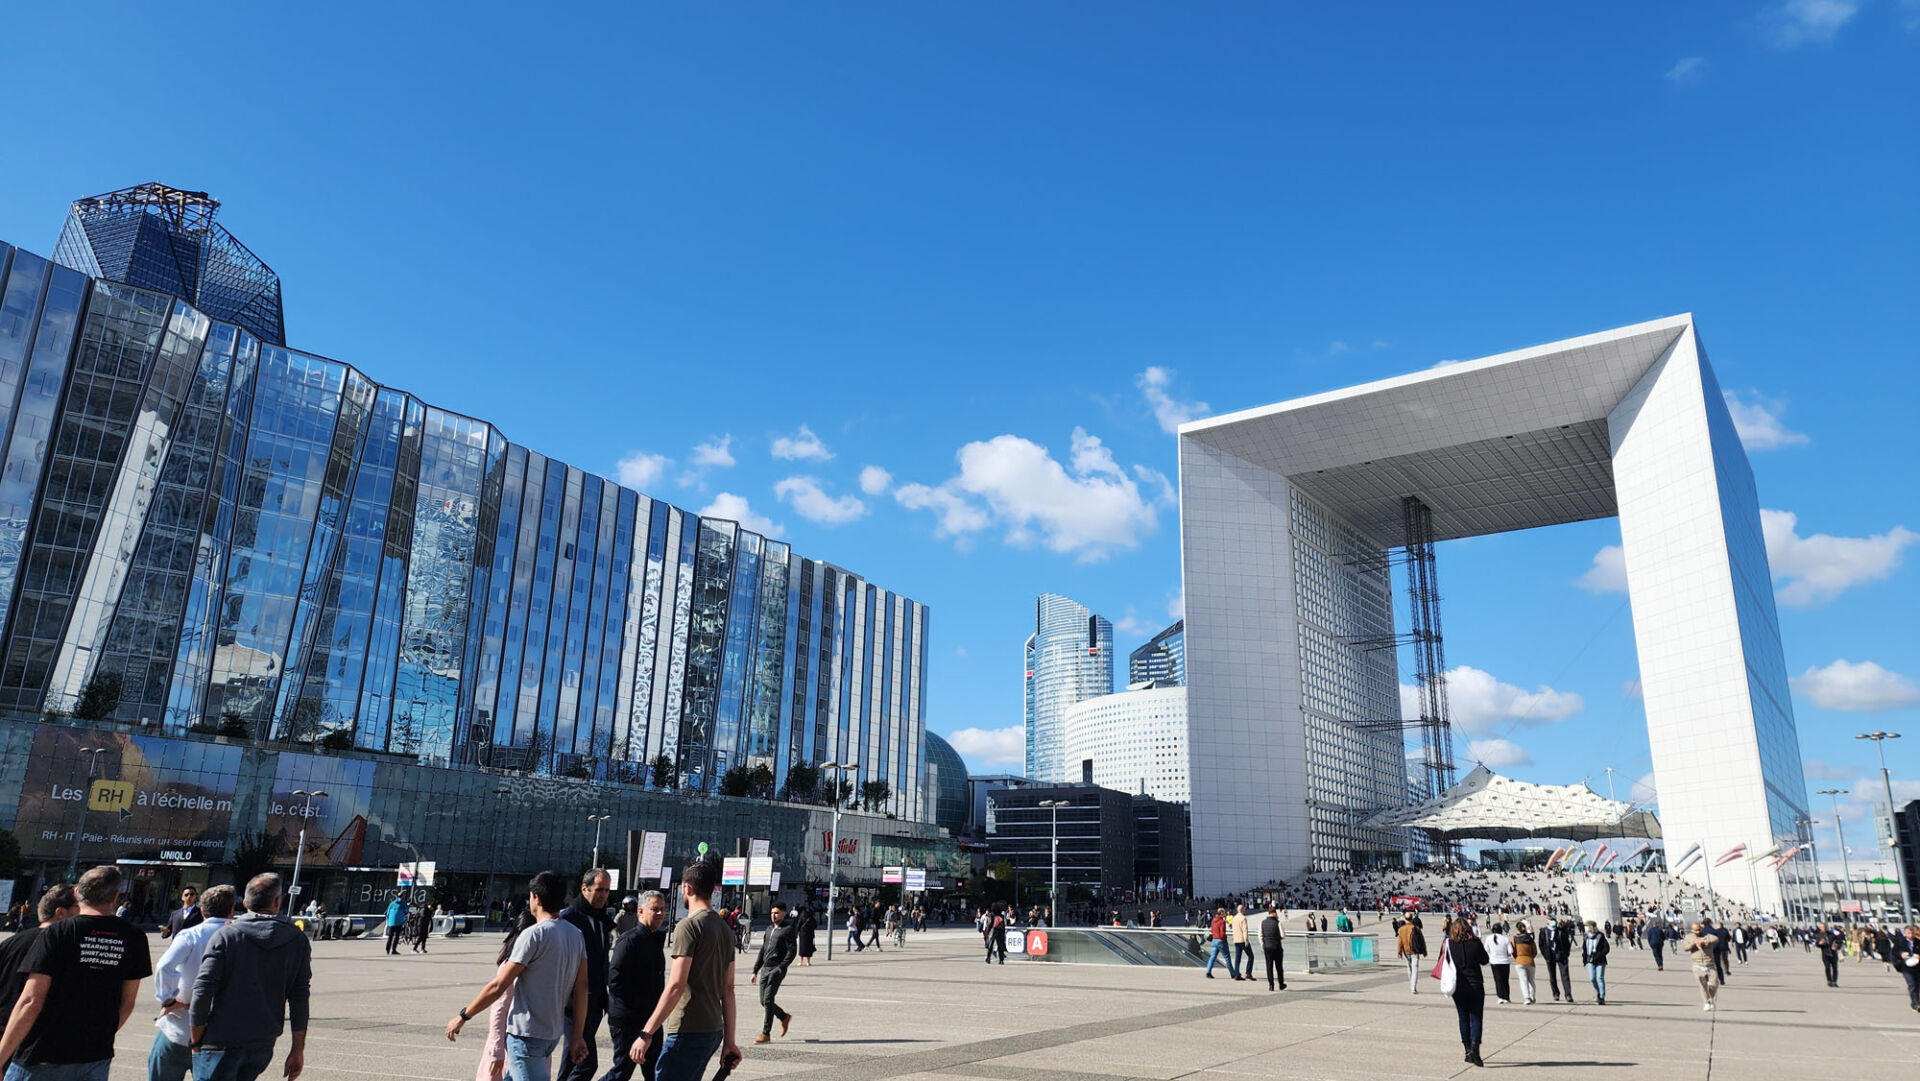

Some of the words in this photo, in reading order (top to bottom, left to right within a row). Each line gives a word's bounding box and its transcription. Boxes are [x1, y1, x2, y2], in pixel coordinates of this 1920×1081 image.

[51, 784, 84, 802] Les
[97, 787, 124, 804] RH
[136, 791, 149, 807] à
[42, 830, 58, 841] RH
[64, 831, 76, 841] IT
[160, 850, 192, 862] UNIQLO
[1007, 937, 1023, 947] RER
[1031, 935, 1043, 951] A
